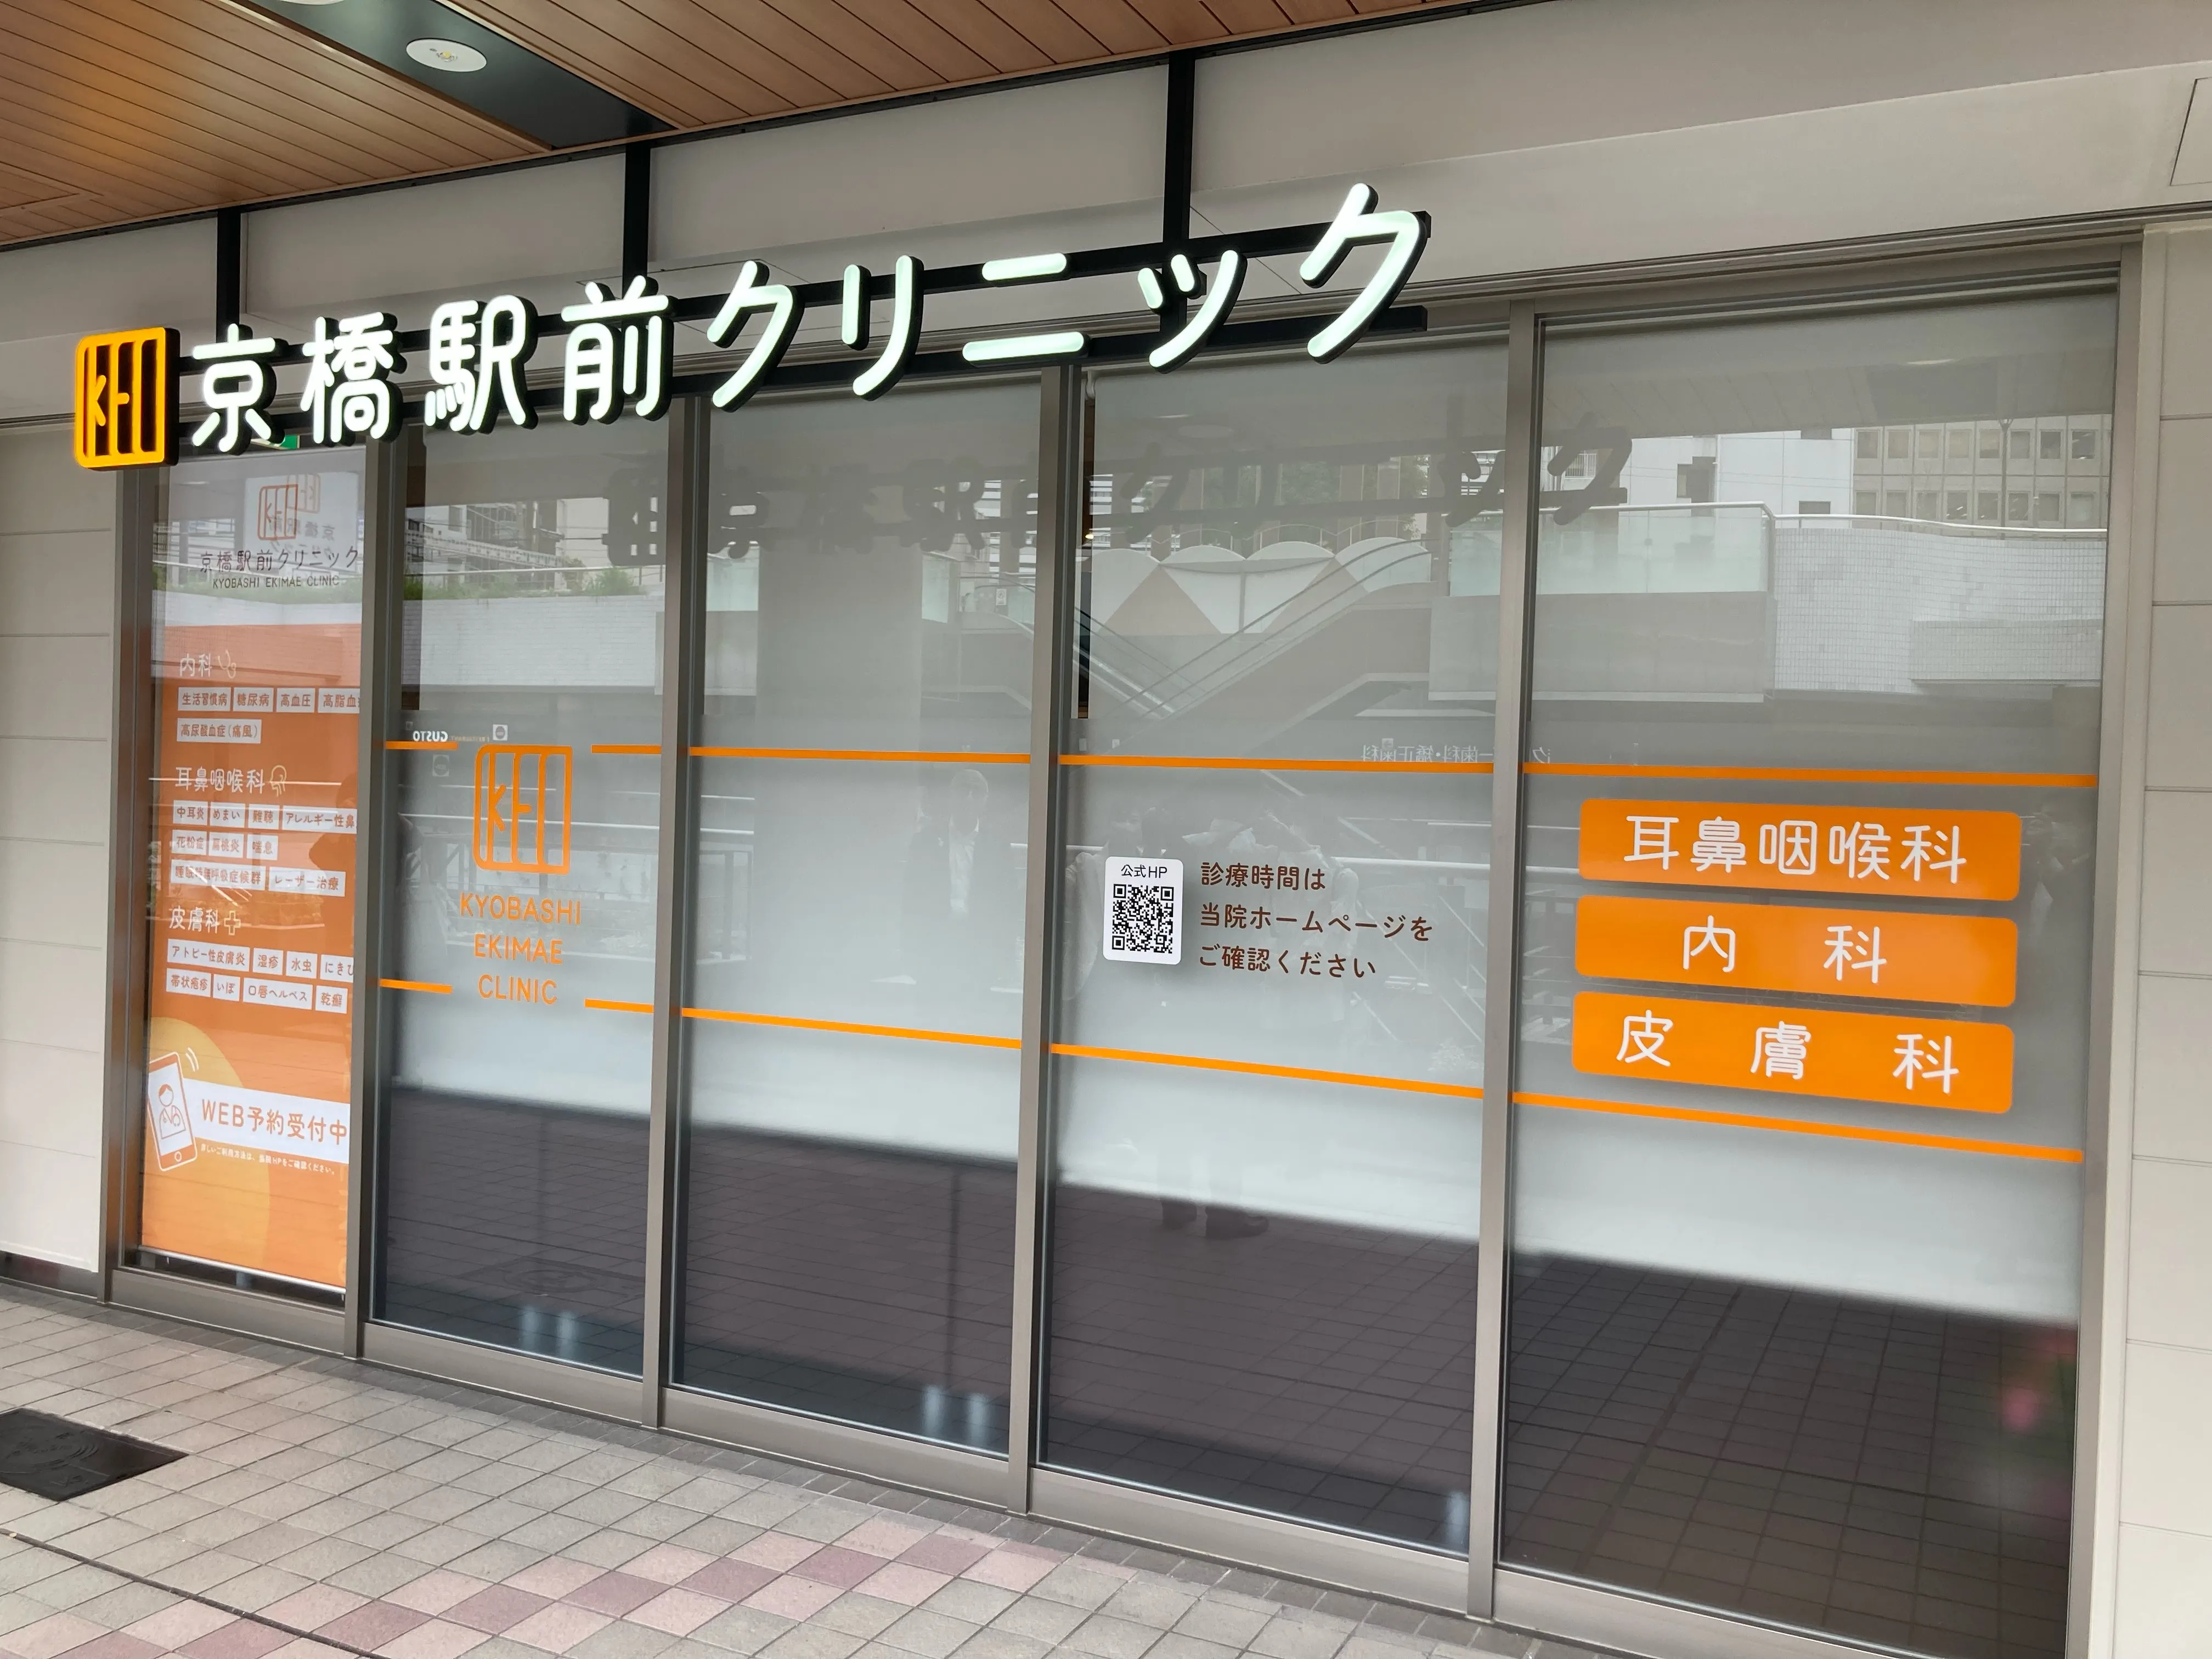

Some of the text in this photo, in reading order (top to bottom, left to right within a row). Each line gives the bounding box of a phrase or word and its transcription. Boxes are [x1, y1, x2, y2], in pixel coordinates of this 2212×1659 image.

[191, 183, 1422, 453] 京橋駅前クリニック
[200, 546, 358, 573] 京橋駅前クリニック
[213, 575, 339, 589] KYOBASHI EKIMAE CLINIC
[179, 653, 212, 677] 内科
[182, 693, 360, 708] 生活習慣病 糖尿病 高血圧 高脂血
[176, 766, 266, 794] 耳鼻咽喉科
[176, 806, 204, 820] 中耳炎
[213, 809, 240, 821] めまい
[252, 810, 273, 823] 難聴
[177, 836, 273, 854] 花粉症 扁桃炎 喘息
[1624, 816, 1967, 884] 耳鼻咽喉科
[275, 875, 340, 891] レーザー治療
[1121, 864, 1167, 879] 公式HP
[1201, 862, 1325, 890] 診療時間は
[169, 905, 219, 934] 皮膚科
[460, 893, 581, 925] KYOBASHI
[1200, 902, 1432, 941] 当院ホームページを
[172, 946, 246, 966] アトピー性皮膚炎
[257, 955, 279, 968] 湿疹
[291, 958, 312, 973] 水虫
[474, 934, 563, 964] EKIMAE
[1199, 945, 1376, 978] ご確認ください
[1683, 915, 1887, 984] 内科
[171, 974, 208, 991] 帯状疱疹
[217, 983, 236, 994] いぼ
[249, 985, 307, 1002] 口唇ヘルペス
[478, 974, 557, 1005] CLINIC
[1616, 1009, 1960, 1094] 皮膚科
[202, 1099, 348, 1146] WEB予約受付中
